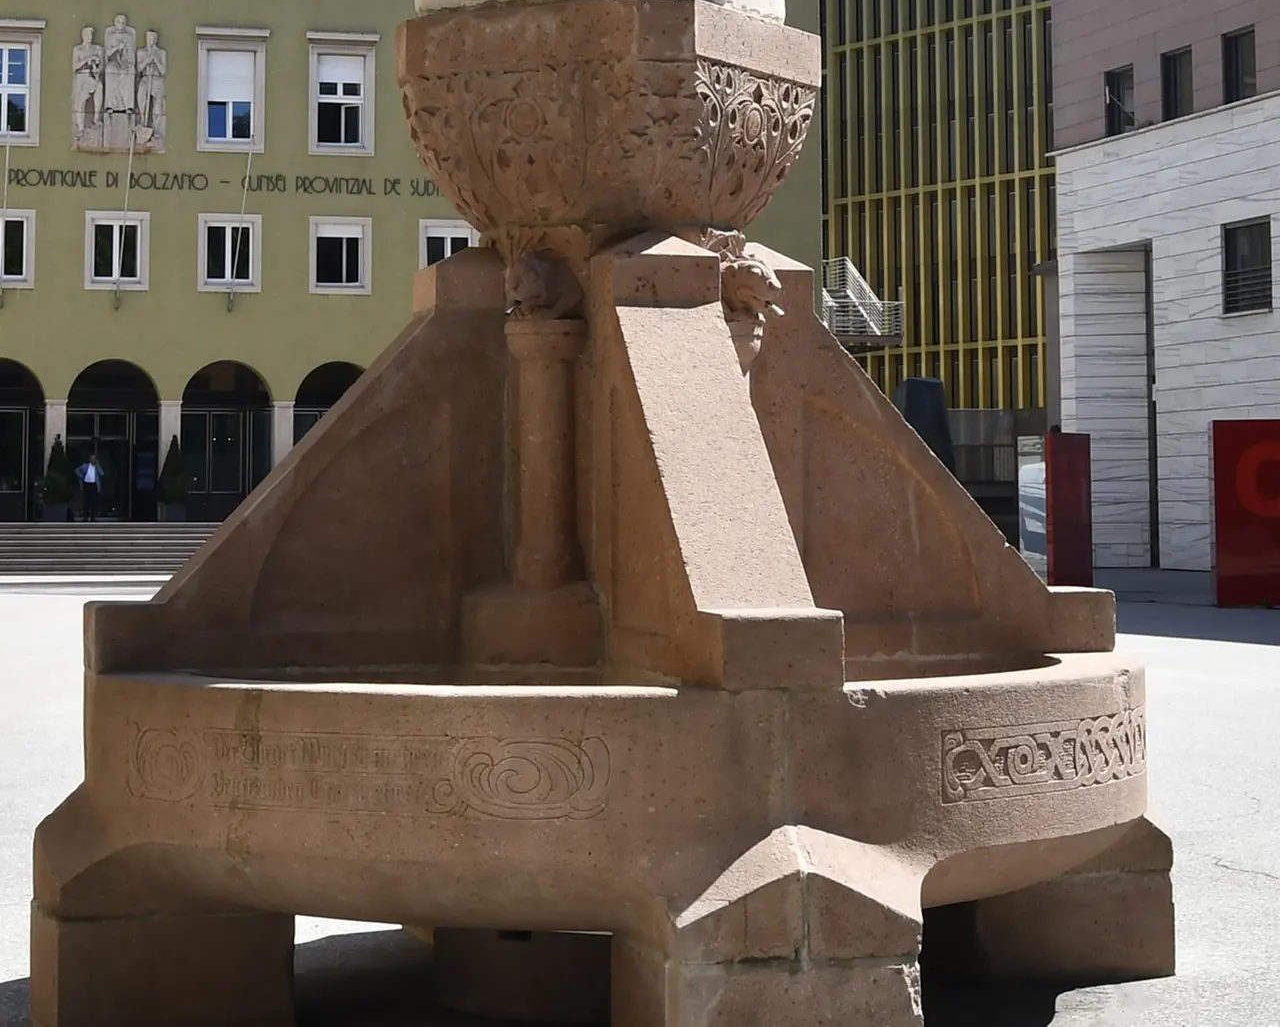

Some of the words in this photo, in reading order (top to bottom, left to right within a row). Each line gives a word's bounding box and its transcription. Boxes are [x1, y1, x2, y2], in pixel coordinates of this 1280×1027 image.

[8, 168, 97, 188] PROVINCIALE
[106, 171, 118, 188] DI
[129, 172, 208, 191] BOLZANO
[384, 178, 401, 196] DE
